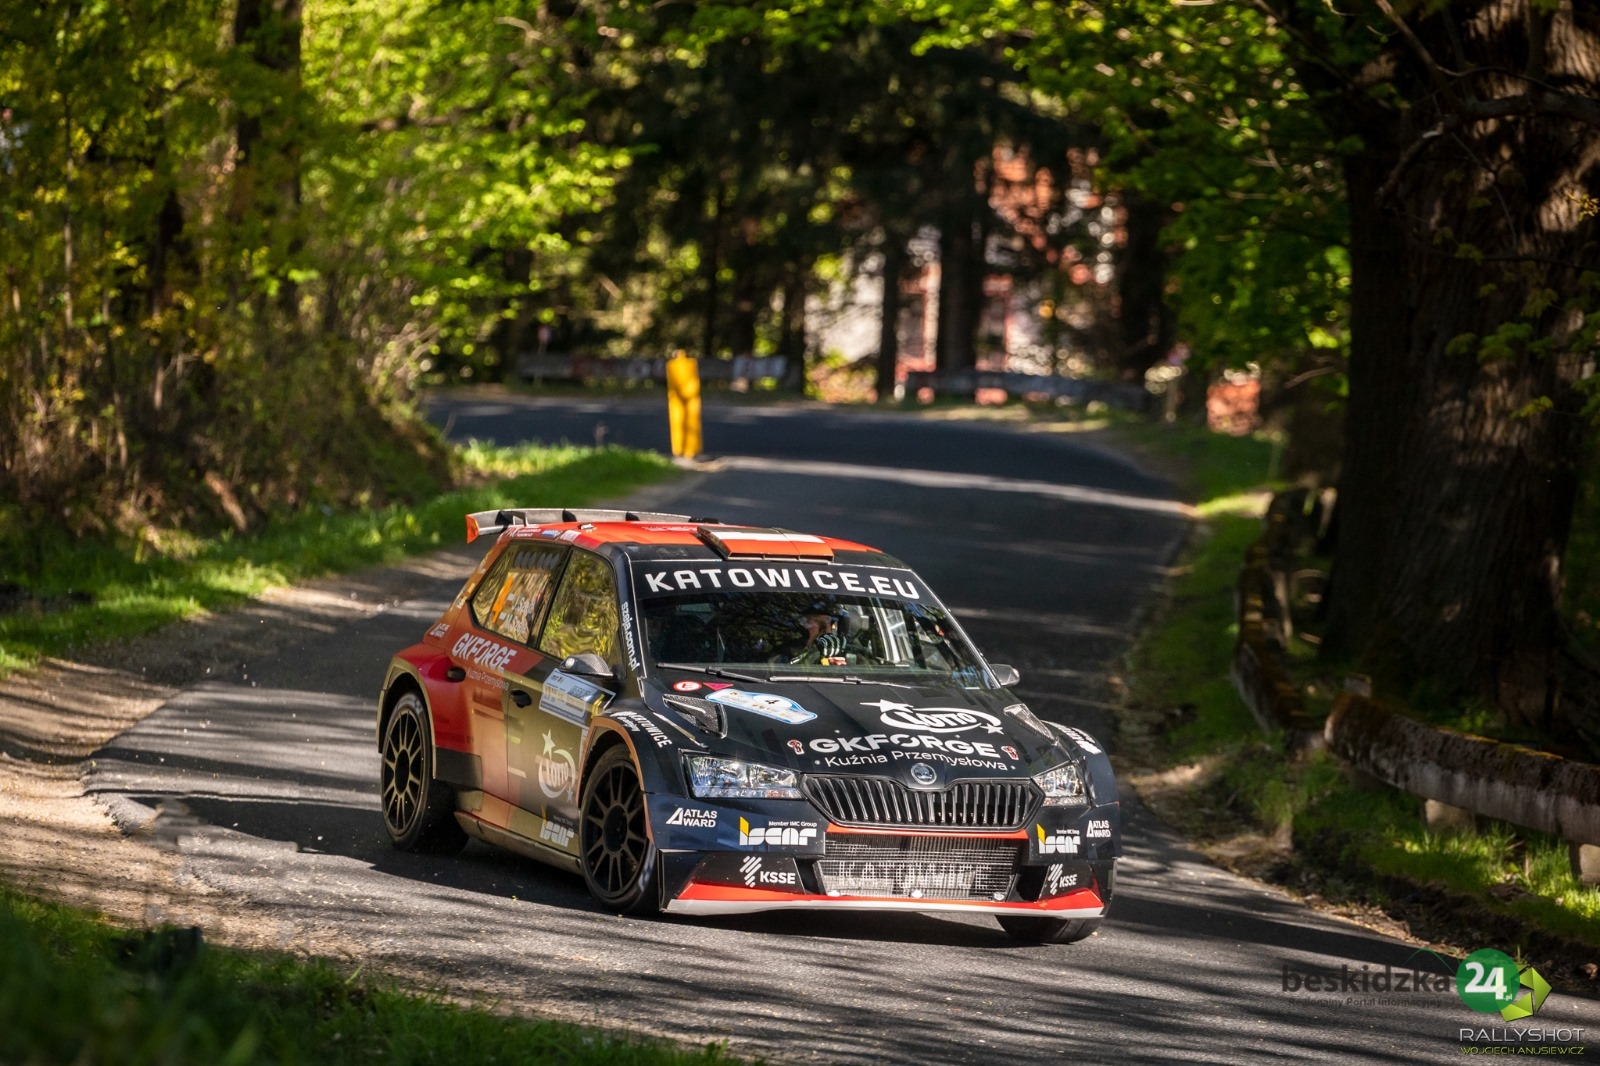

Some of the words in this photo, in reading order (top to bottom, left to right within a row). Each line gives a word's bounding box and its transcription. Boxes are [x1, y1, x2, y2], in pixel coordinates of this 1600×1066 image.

[645, 567, 920, 600] KATOWICE.EU
[621, 601, 641, 672] szeja.com.pl
[452, 632, 518, 674] GKFORGE
[893, 711, 978, 728] LOTTO
[809, 733, 1001, 758] GKFORGE
[824, 753, 888, 767] Kuźnia
[891, 750, 1008, 771] Przemysłowa
[683, 809, 718, 819] ATLAS
[683, 818, 716, 828] WARD
[1092, 820, 1110, 829] ATLAS
[1092, 829, 1111, 838] WARD
[759, 871, 796, 885] KSSE
[1059, 873, 1078, 888] KSSE
